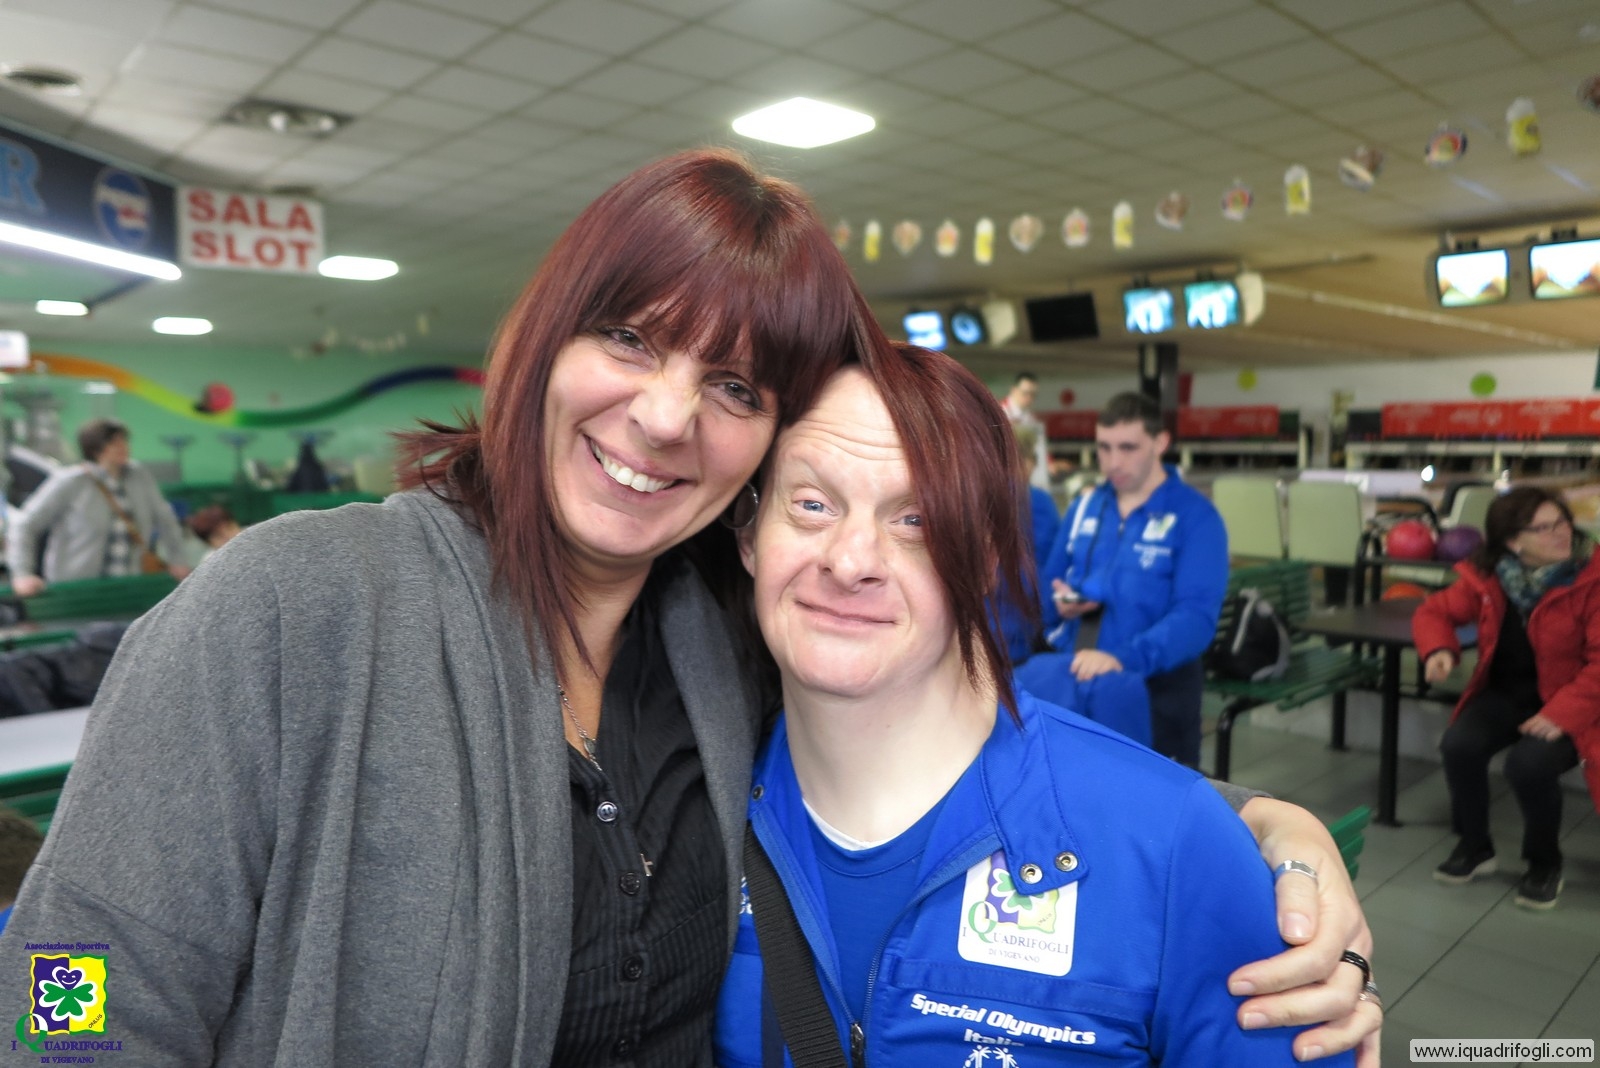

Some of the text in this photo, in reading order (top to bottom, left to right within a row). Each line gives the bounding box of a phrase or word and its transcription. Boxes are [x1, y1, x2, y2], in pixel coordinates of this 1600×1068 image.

[187, 190, 314, 232] SALA
[191, 230, 314, 271] SLOT
[910, 993, 1097, 1046] Special Olympics
